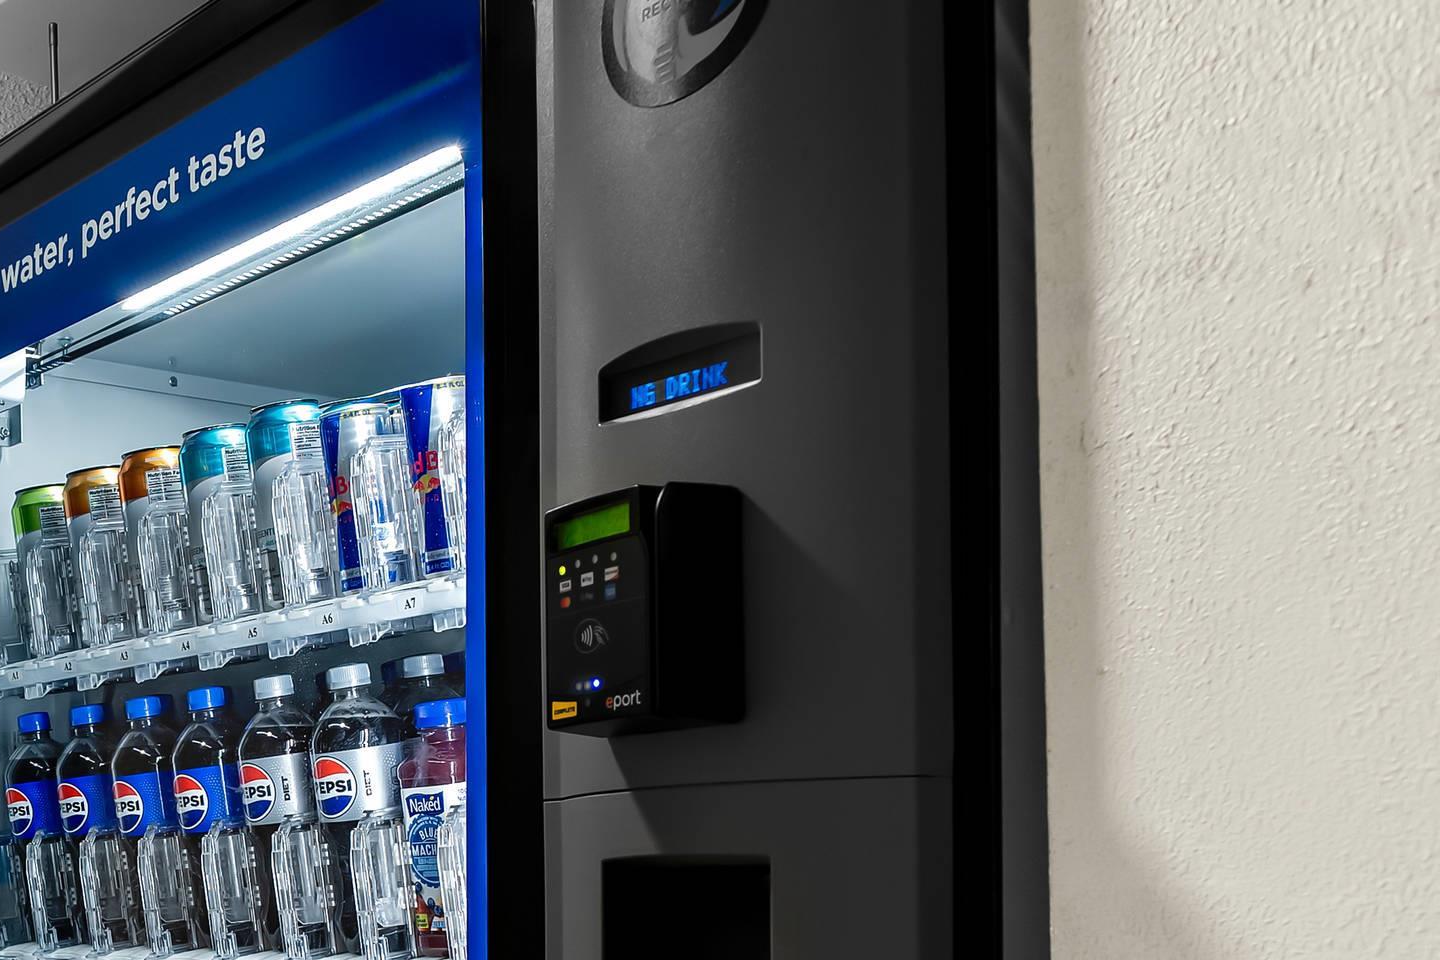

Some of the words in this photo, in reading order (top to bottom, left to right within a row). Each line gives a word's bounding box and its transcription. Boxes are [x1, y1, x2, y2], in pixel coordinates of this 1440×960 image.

[1, 232, 74, 293] water,
[81, 167, 181, 258] perfect
[187, 127, 266, 193] taste
[666, 361, 728, 400] DRINK
[64, 662, 72, 671] A2
[119, 652, 128, 661] A3
[180, 642, 190, 651] A4
[247, 628, 258, 638] A5
[322, 613, 333, 625] A6
[404, 598, 416, 610] A7
[606, 689, 641, 711] eport
[245, 785, 272, 799] EPSI
[281, 775, 291, 801] DIET
[315, 780, 352, 795] EPSI
[61, 801, 85, 813] EPSI
[117, 800, 140, 812] EPSI
[179, 795, 205, 808] EPSI
[409, 798, 441, 813] Naked
[8, 806, 30, 817] EPSI
[412, 843, 438, 857] MACH
